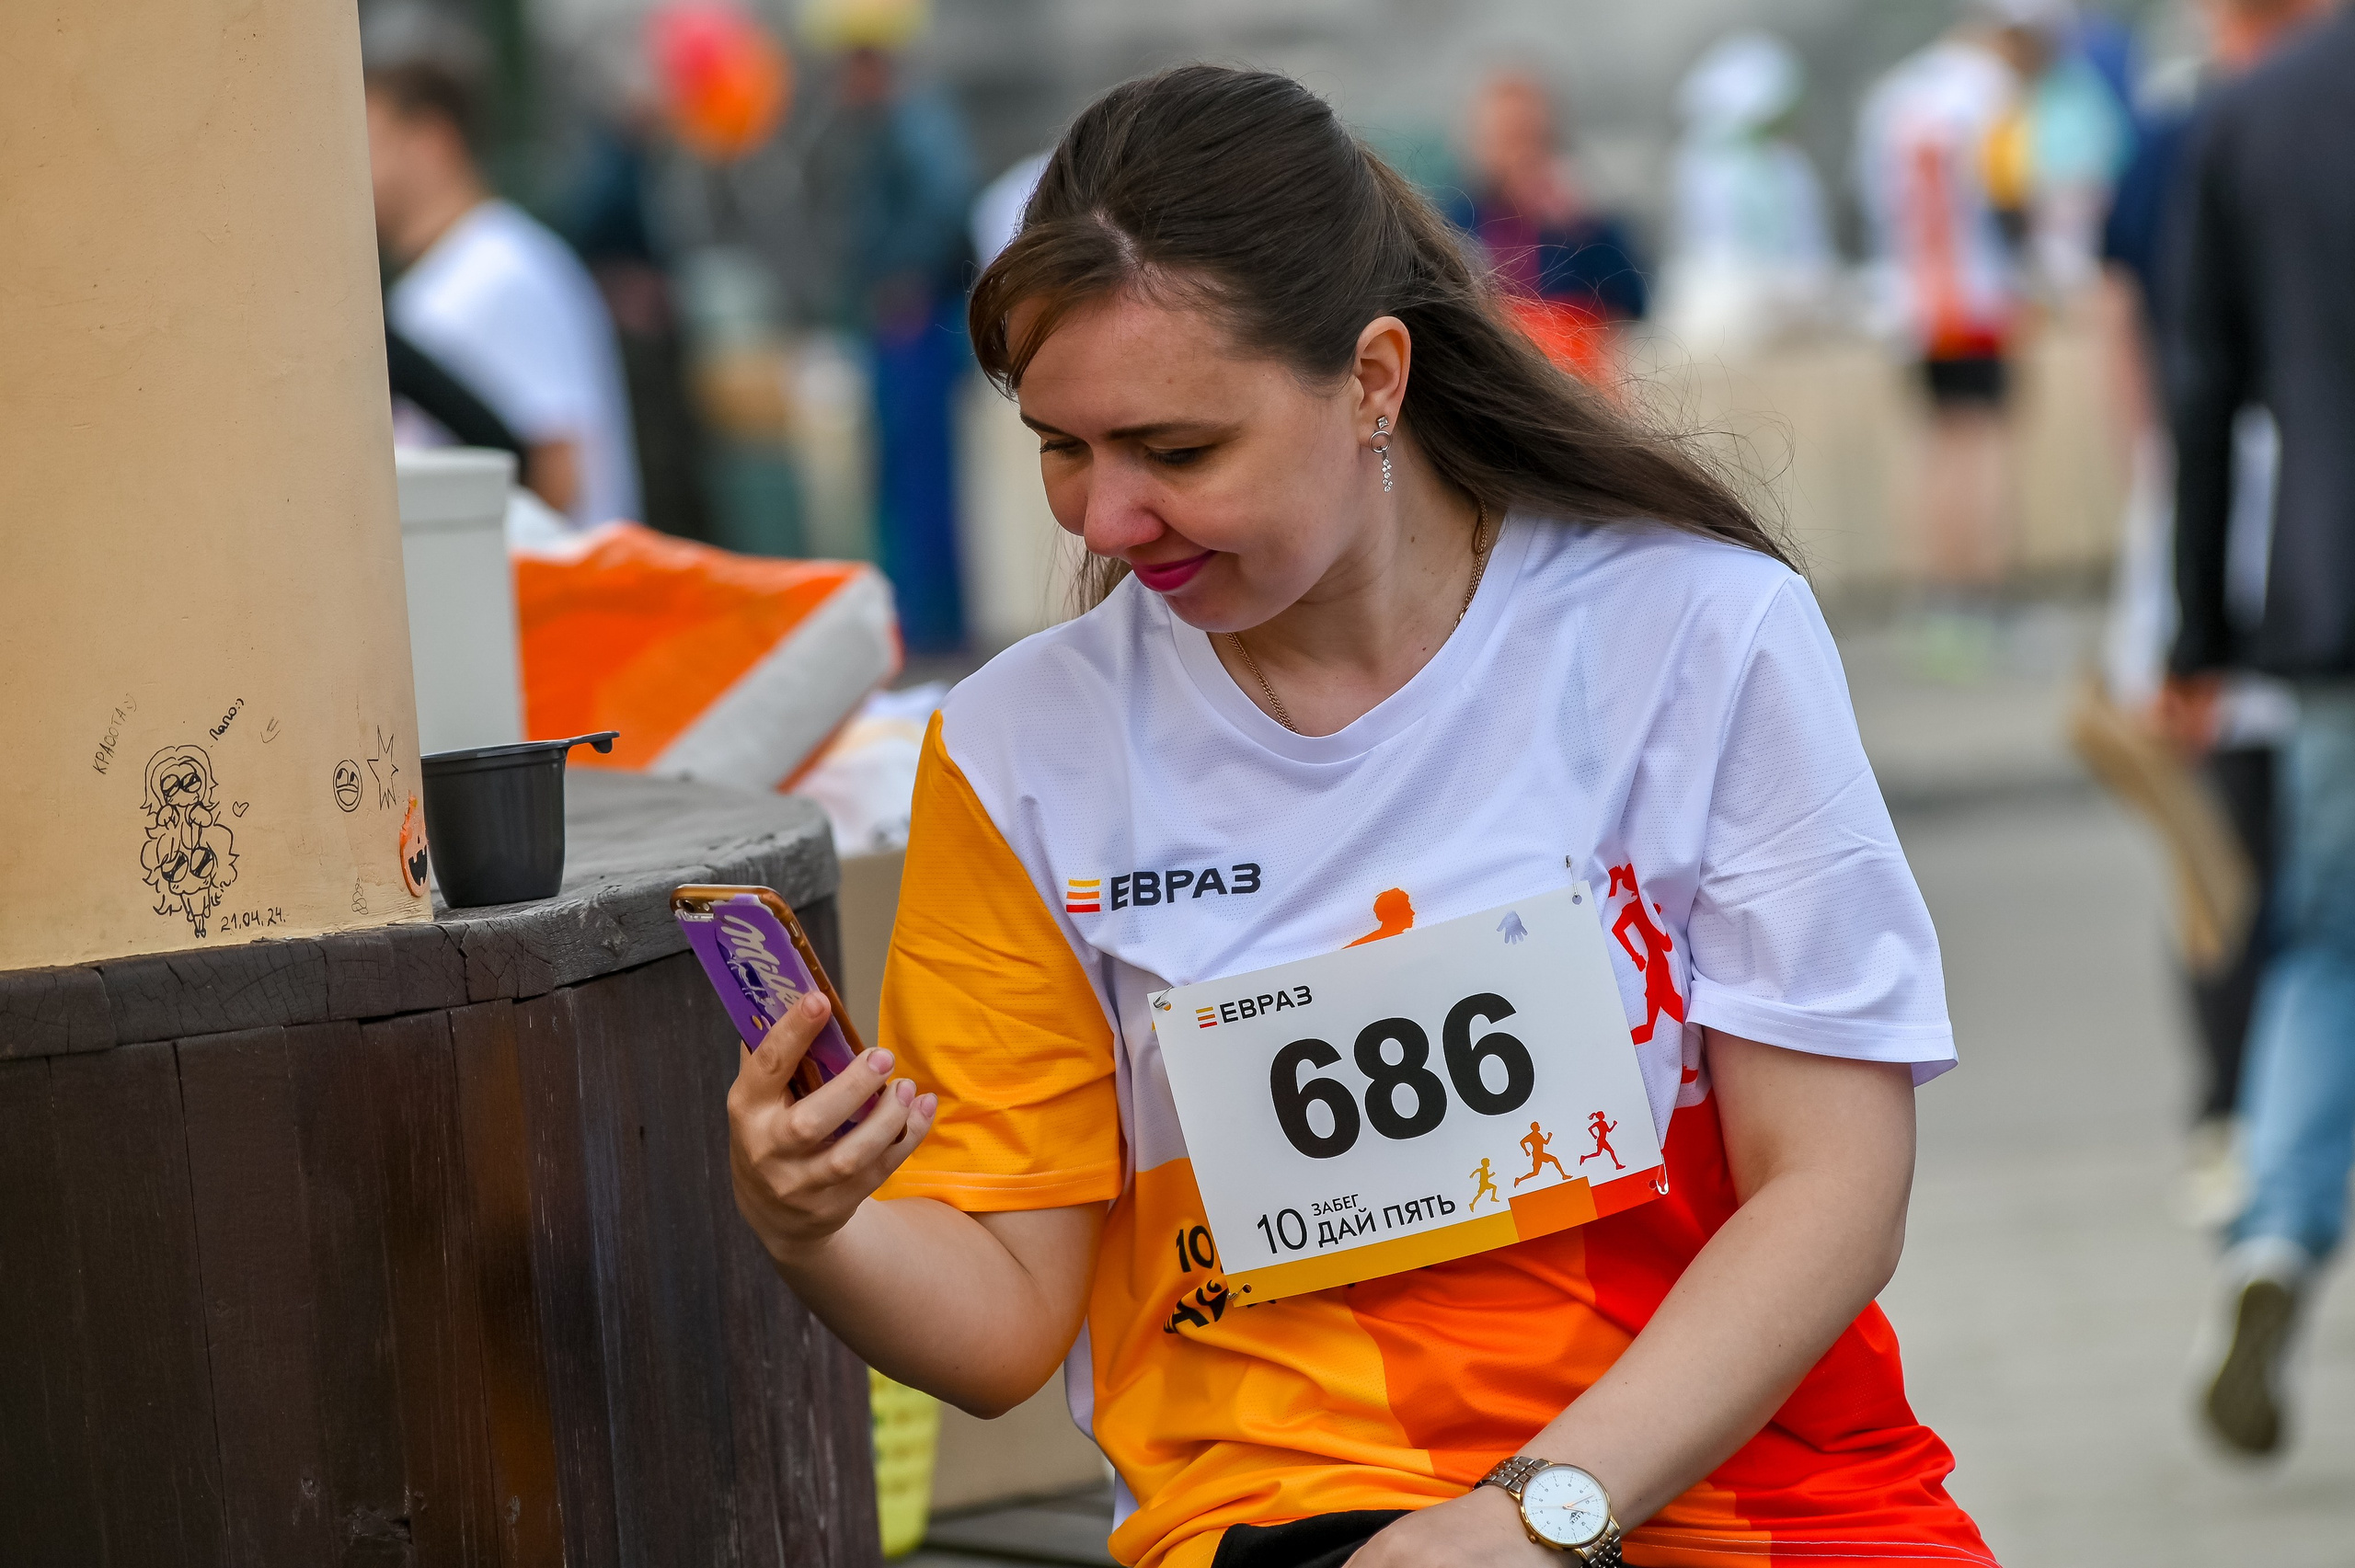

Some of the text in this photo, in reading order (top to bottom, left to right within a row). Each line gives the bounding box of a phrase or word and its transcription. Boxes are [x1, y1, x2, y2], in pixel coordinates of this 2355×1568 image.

[1110, 863, 1261, 911] ЕВРАЗ
[720, 915, 804, 1012] Milk
[1219, 985, 1313, 1024] ЕВРАЗ
[1269, 992, 1535, 1160] 686
[1257, 1195, 1456, 1254] 10 ДАЙ ПЯТЬ
[1311, 1194, 1359, 1217] ЗАБЕГ
[1176, 1225, 1214, 1273] 10
